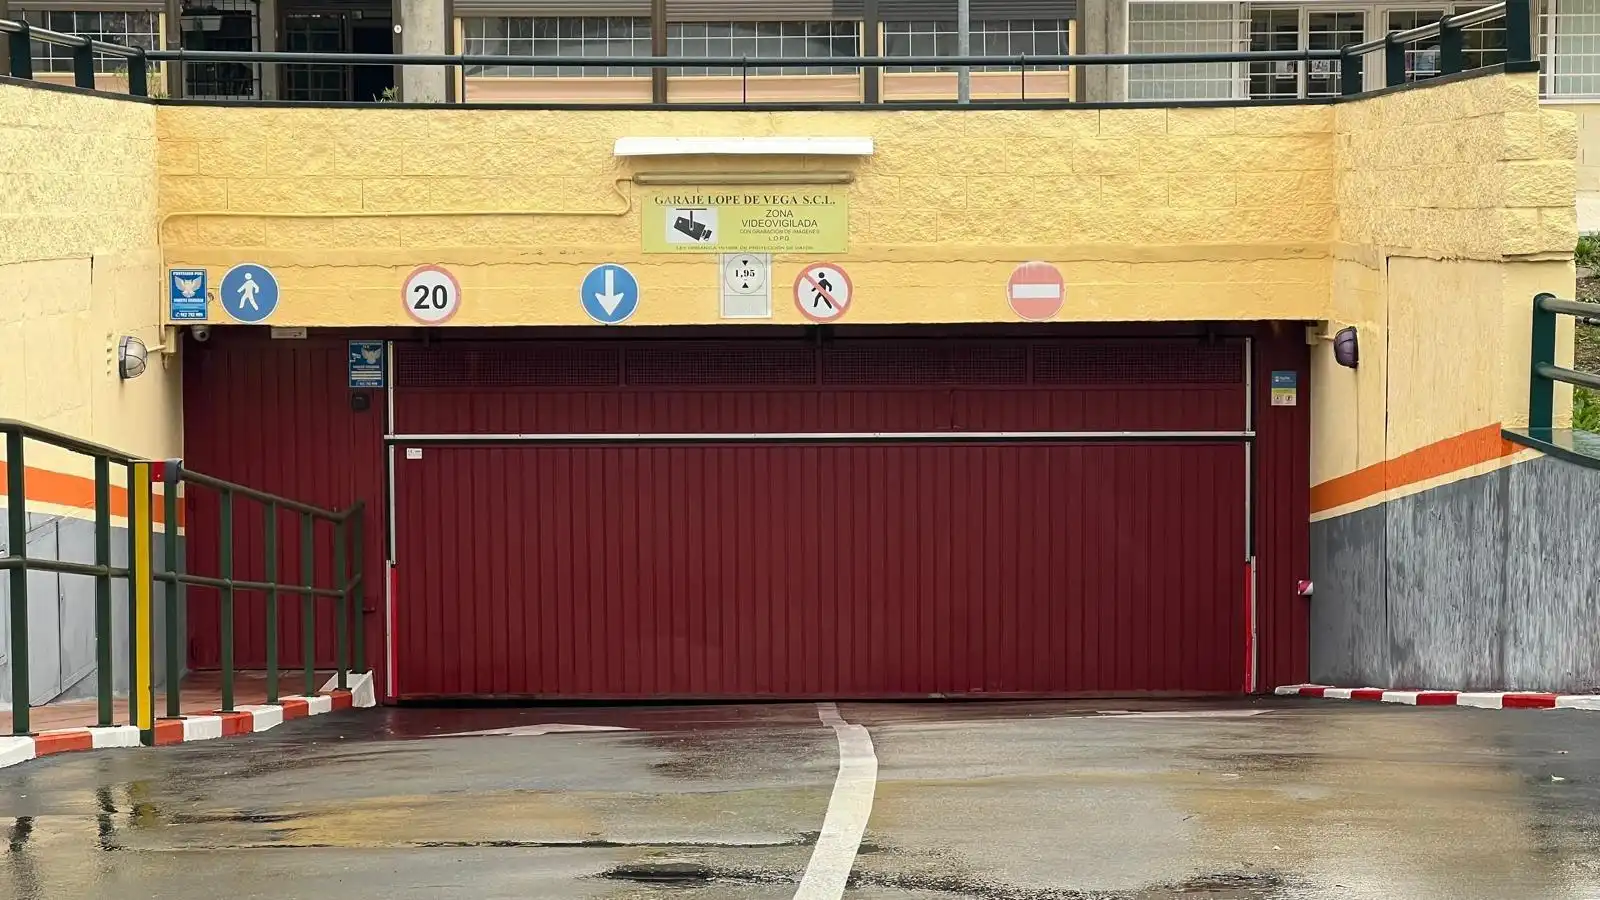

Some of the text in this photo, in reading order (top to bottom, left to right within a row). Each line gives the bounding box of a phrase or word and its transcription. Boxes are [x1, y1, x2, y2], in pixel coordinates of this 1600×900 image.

[654, 195, 836, 205] GARAJE LOPE DE VEGA S.C.L.
[765, 209, 794, 218] ZONA
[741, 219, 818, 228] VIDEOVIGILADA
[735, 269, 756, 278] 1,95
[413, 284, 448, 310] 20
